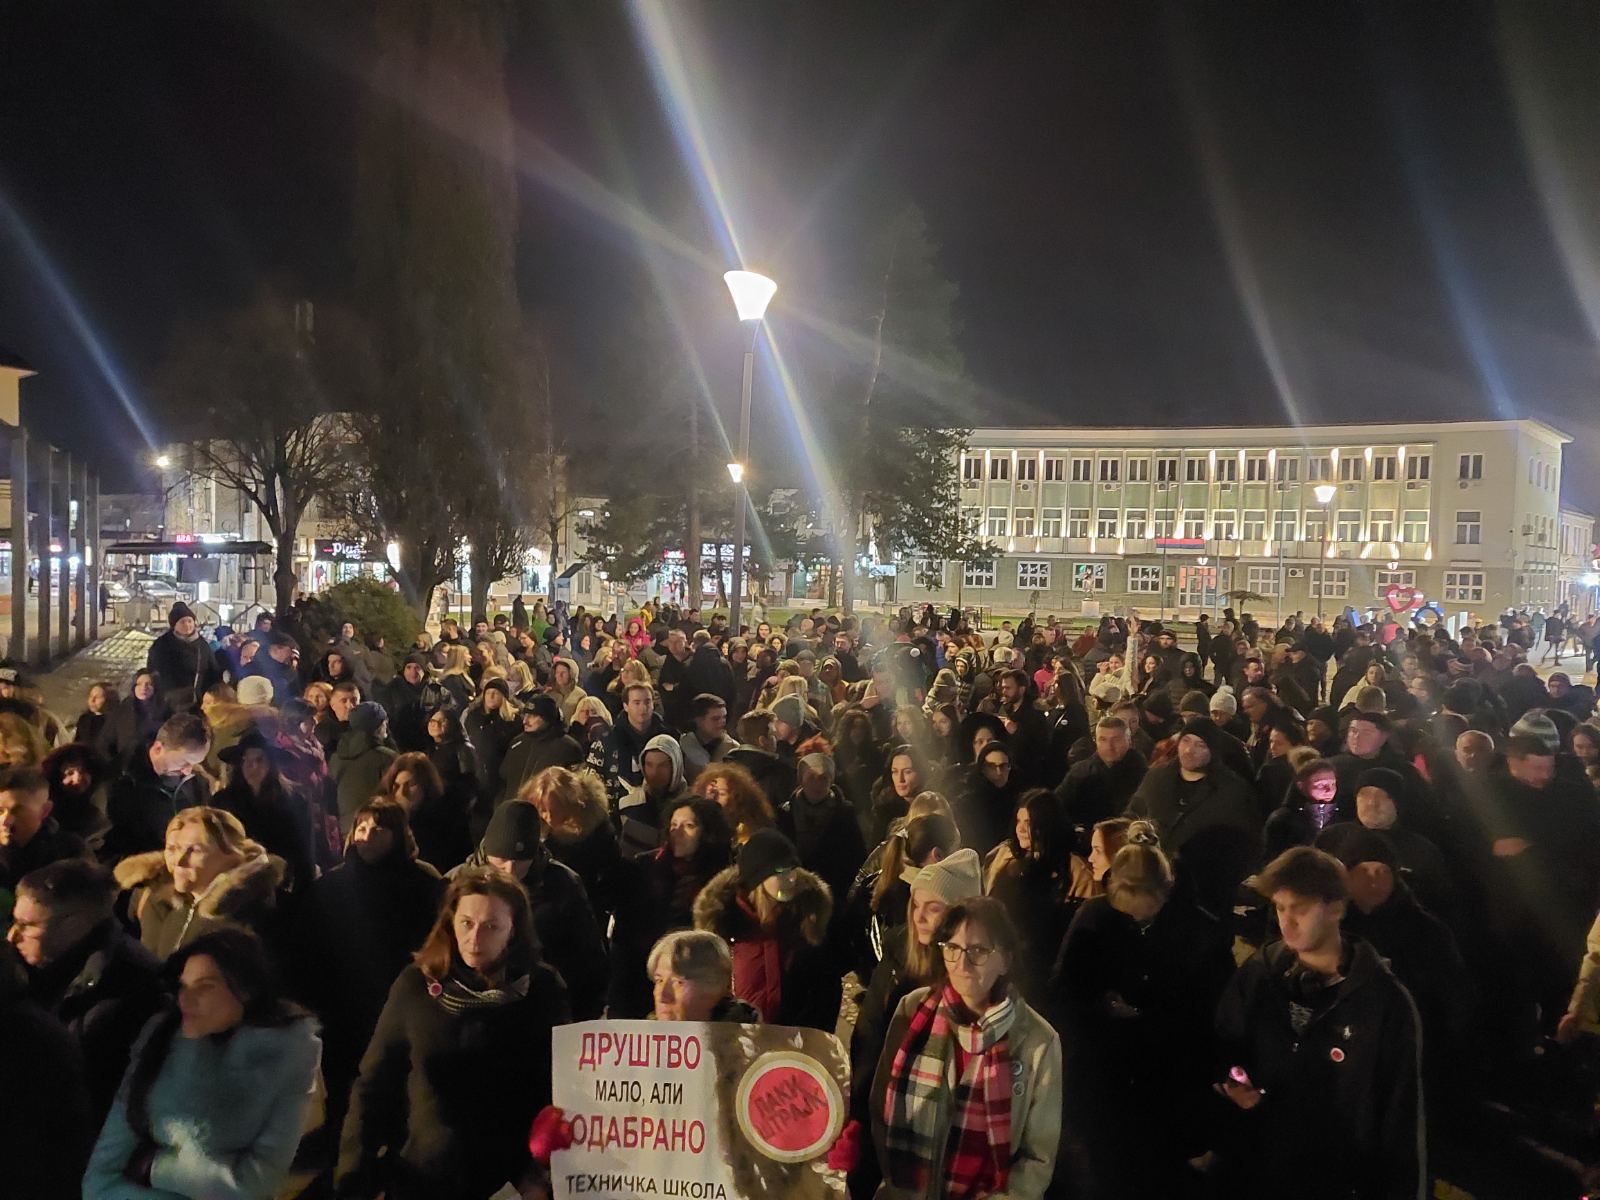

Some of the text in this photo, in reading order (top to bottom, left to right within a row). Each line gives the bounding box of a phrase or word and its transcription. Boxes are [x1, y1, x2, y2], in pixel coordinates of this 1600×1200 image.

[579, 1033, 701, 1071] ДРУШТВО
[595, 1080, 683, 1106] МАЛО, АЛИ
[571, 1114, 705, 1153] ОДАБРАНО
[565, 1173, 727, 1200] ТЕХНИЧКА ШКОЛА
